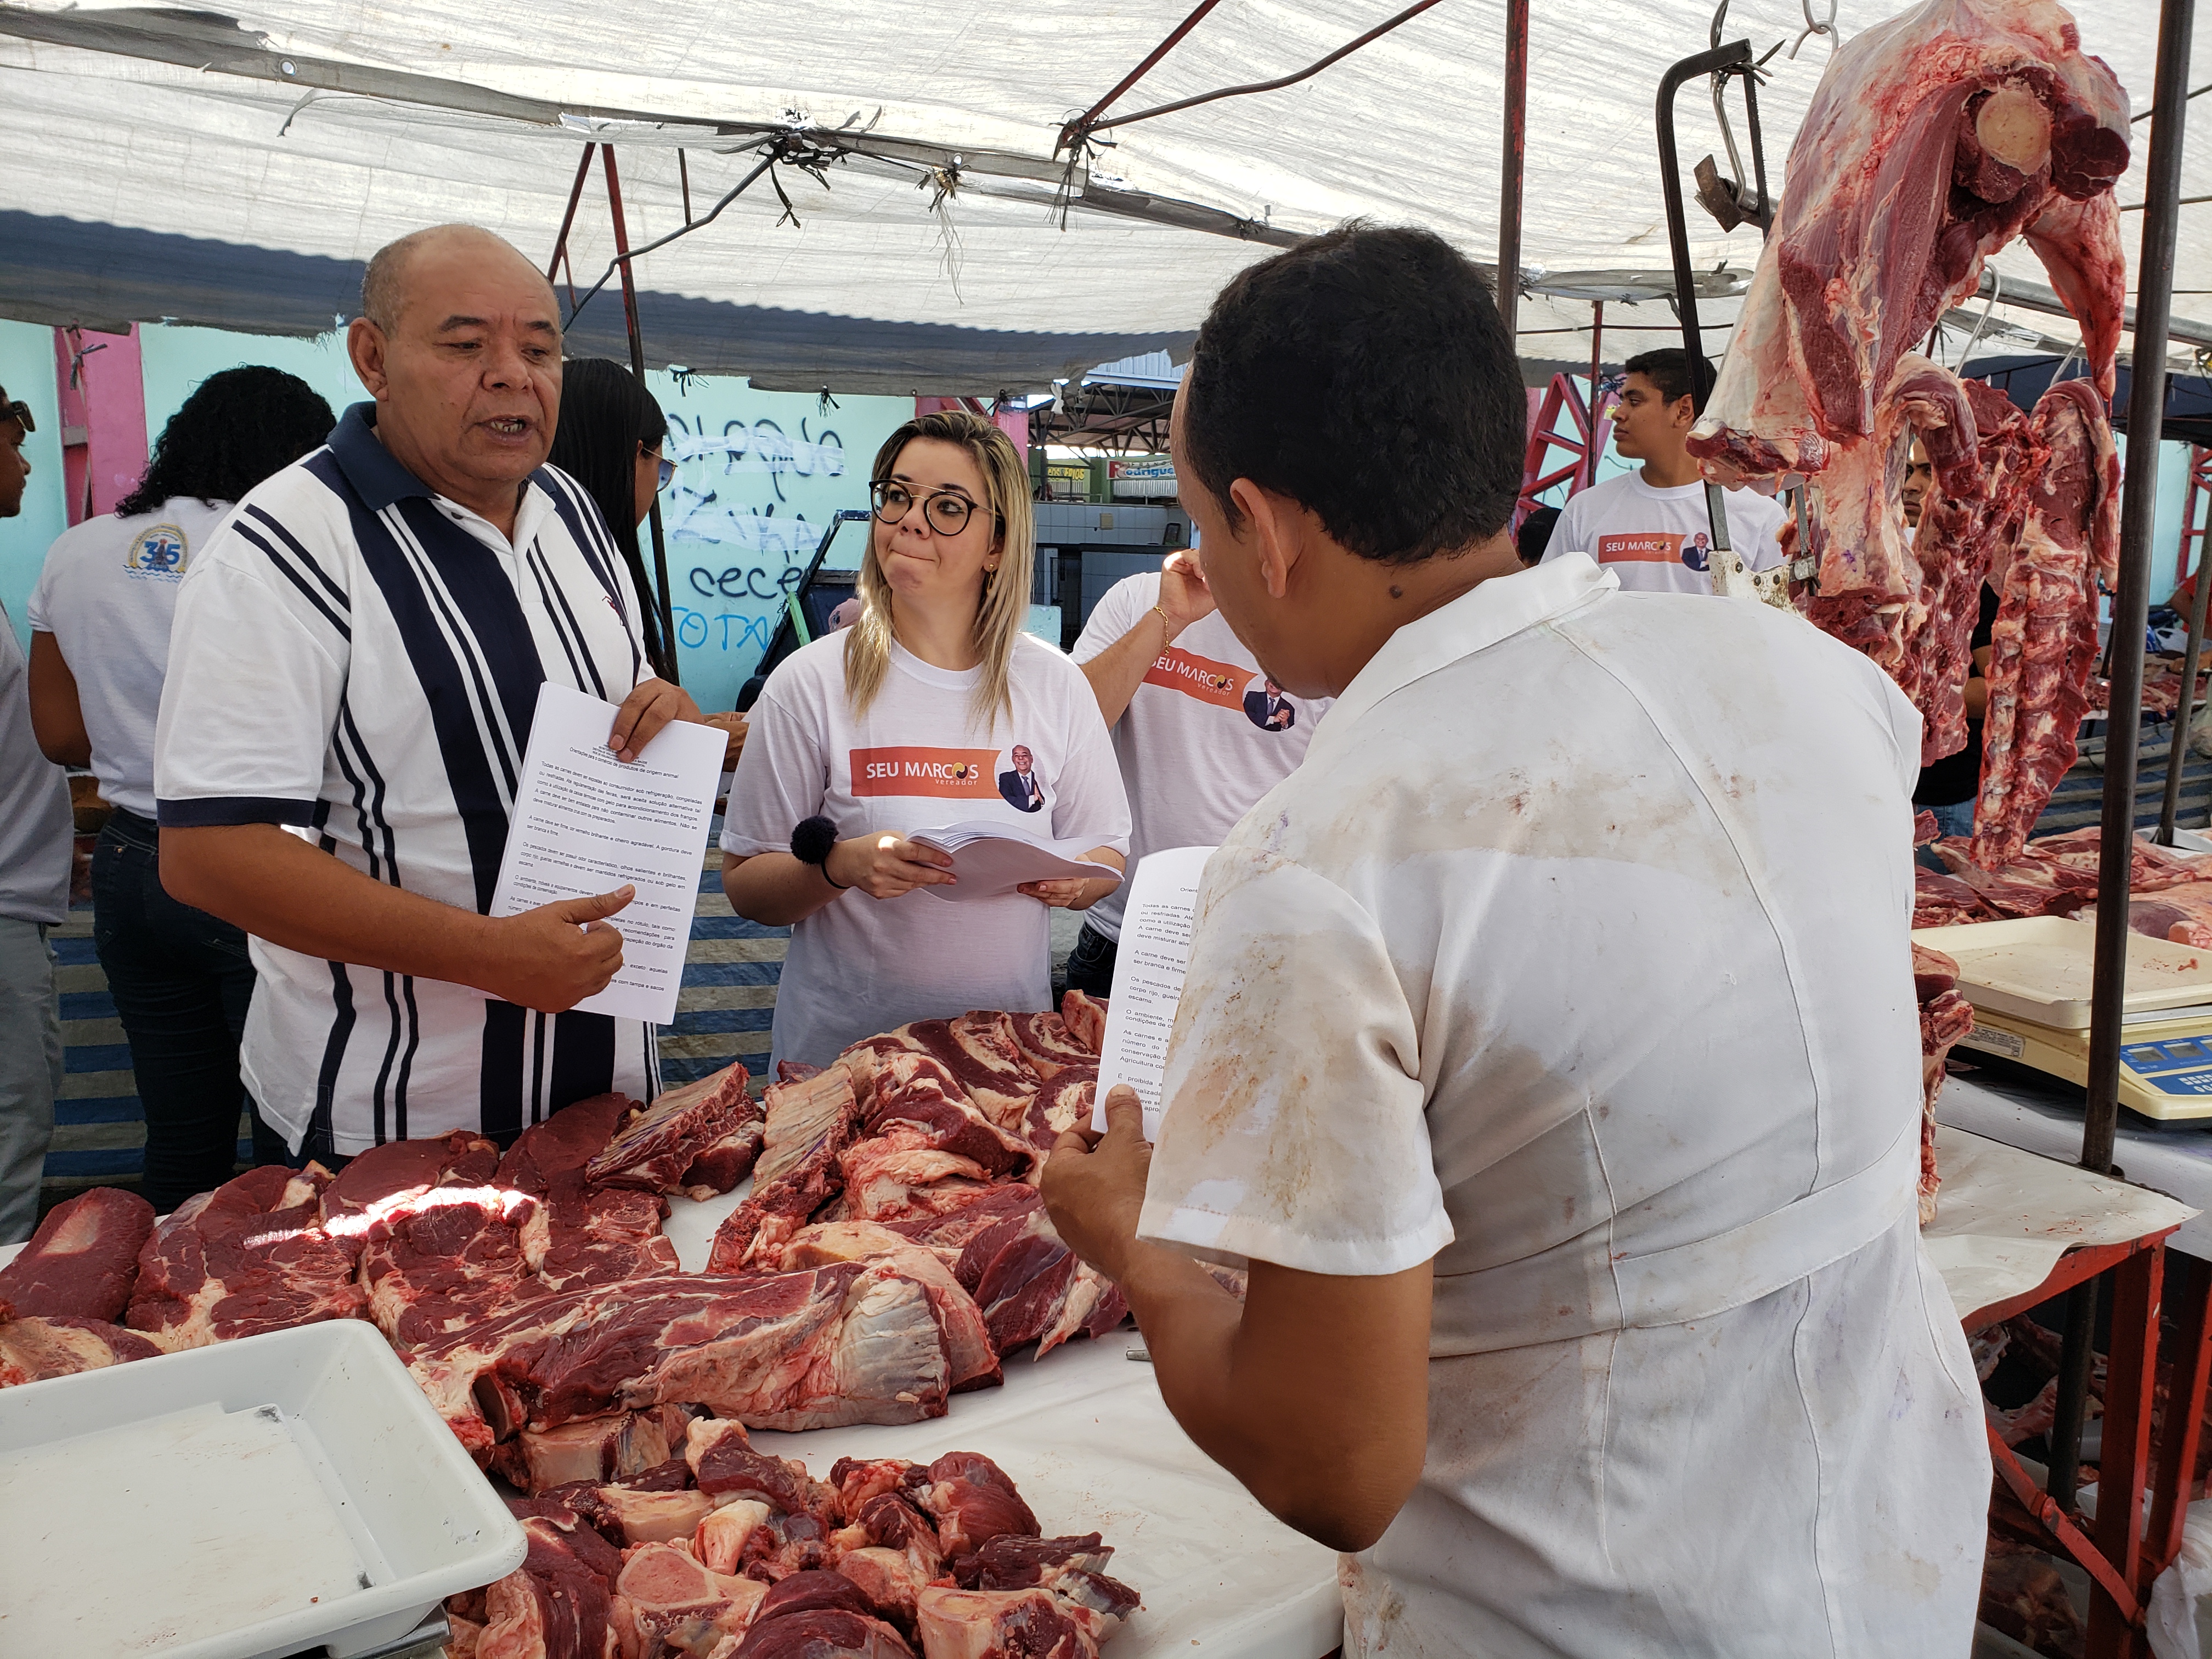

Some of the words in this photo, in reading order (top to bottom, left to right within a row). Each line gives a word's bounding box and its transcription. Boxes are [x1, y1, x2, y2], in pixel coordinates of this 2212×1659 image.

[1606, 542, 1625, 552] SEU
[1628, 541, 1672, 551] MARCOS
[1177, 662, 1234, 691] MARCOS
[1198, 683, 1230, 696] vereador
[866, 761, 899, 779] SEU
[905, 762, 979, 779] MARCOS
[1144, 961, 1164, 969] branca
[1142, 980, 1171, 989] pescados
[1126, 1016, 1156, 1025] condições
[1135, 1012, 1164, 1022] ambiente,
[1121, 1048, 1161, 1059] conservação
[1120, 1056, 1153, 1067] Agricultura
[1128, 1076, 1153, 1085] proibida
